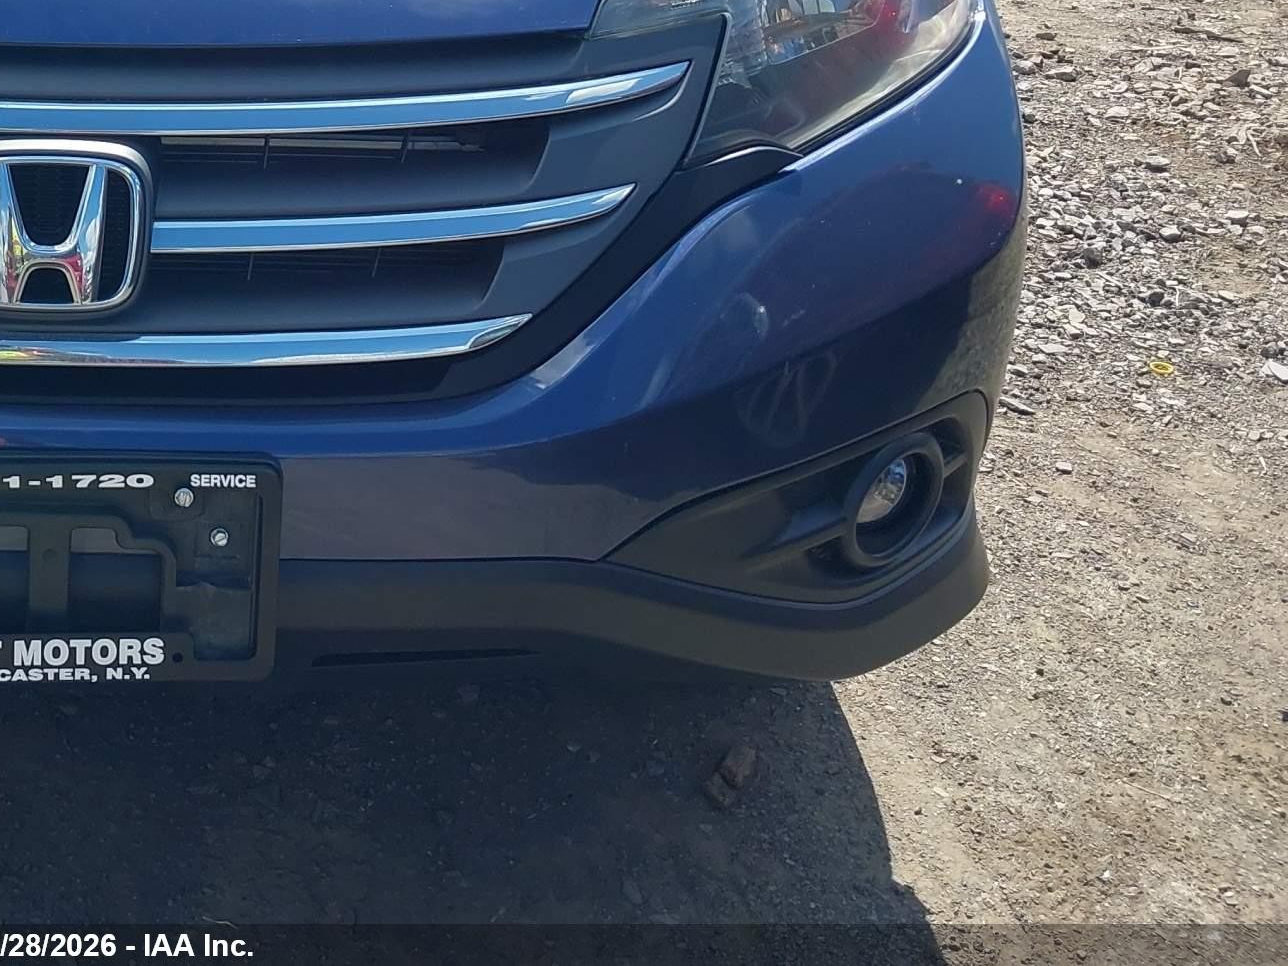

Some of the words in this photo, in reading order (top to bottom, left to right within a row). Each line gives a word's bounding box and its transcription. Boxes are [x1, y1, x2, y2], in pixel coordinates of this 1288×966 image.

[190, 473, 257, 488] SERVICE
[13, 637, 165, 666] MOTORS
[106, 666, 151, 681] N.Y.
